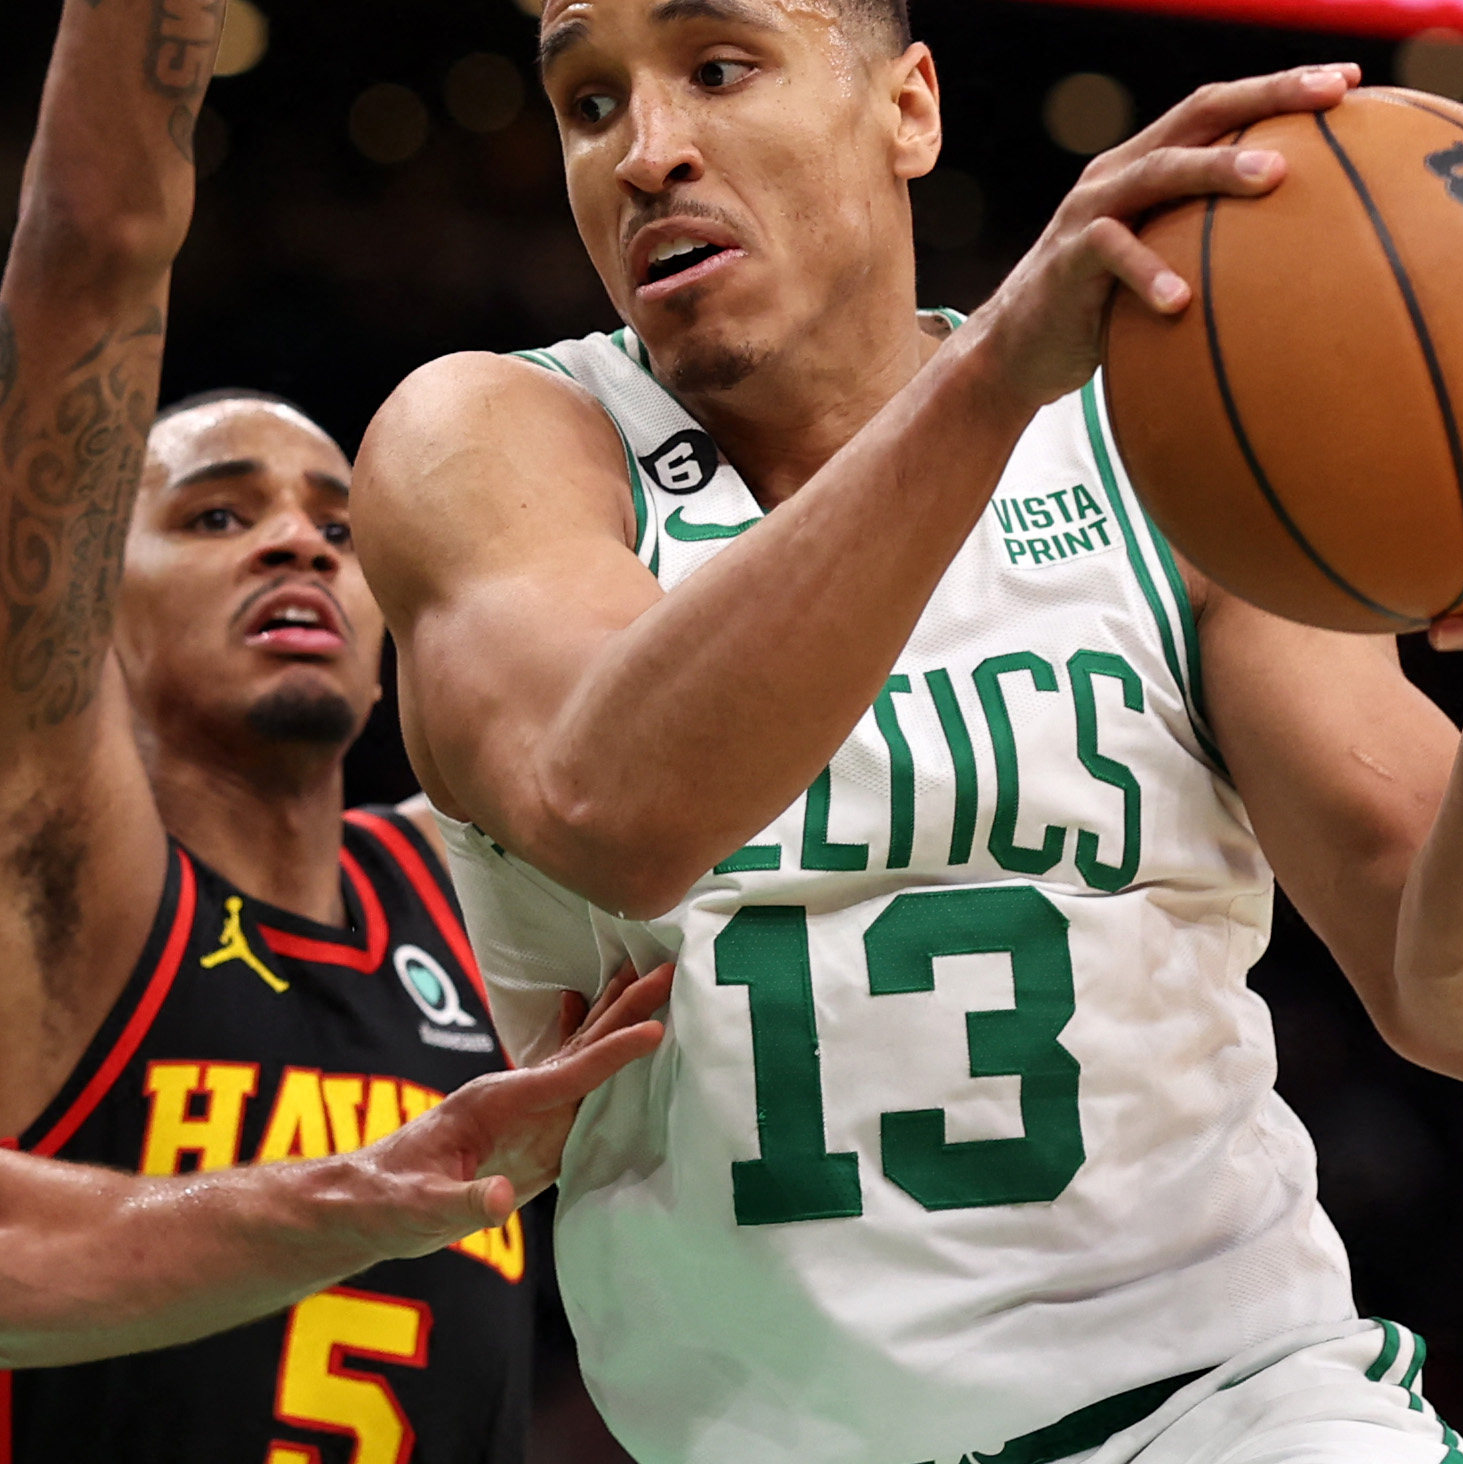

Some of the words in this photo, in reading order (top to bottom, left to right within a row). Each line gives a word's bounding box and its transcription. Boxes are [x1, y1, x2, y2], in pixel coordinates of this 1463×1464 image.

[654, 442, 703, 490] 6
[990, 483, 1103, 534] VISTA
[1003, 516, 1112, 565] PRINT
[713, 649, 1145, 894] LTICS
[714, 885, 1086, 1226] 13
[263, 1283, 436, 1464] 5
